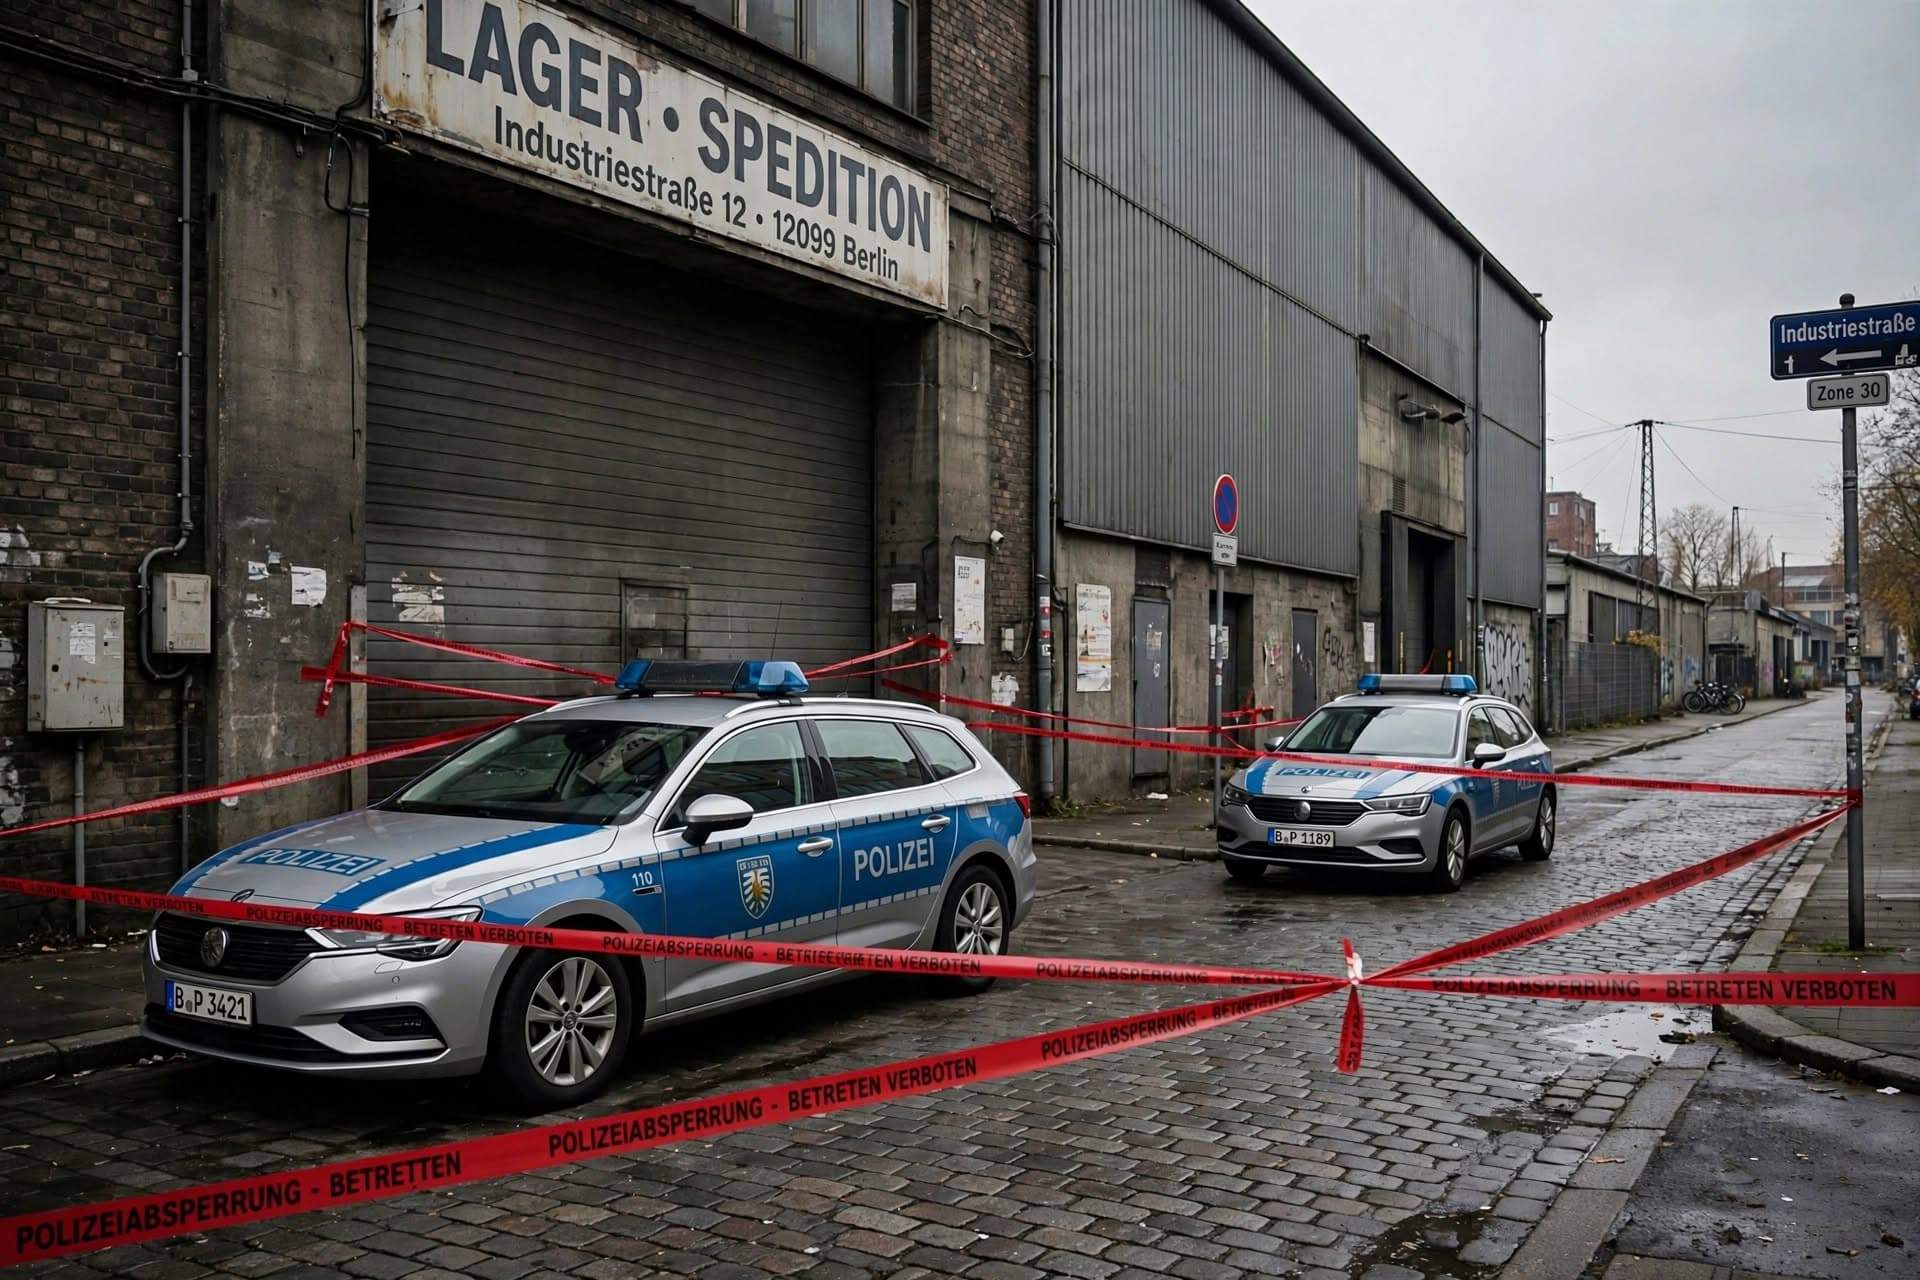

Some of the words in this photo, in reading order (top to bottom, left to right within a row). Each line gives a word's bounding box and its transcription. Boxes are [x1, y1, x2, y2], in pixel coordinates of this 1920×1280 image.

[426, 0, 643, 144] LAGER
[697, 97, 932, 253] SPEDITION
[495, 105, 713, 217] Industriestraße
[721, 192, 747, 229] 12
[772, 210, 836, 259] 12099
[843, 241, 899, 281] Berlin
[1781, 312, 1916, 343] Industriestraße
[1817, 386, 1854, 401] Zone
[1861, 382, 1881, 398] 30
[1280, 767, 1367, 779] POLIZEI
[1275, 830, 1283, 842] B
[1290, 832, 1298, 842] P
[1301, 832, 1331, 845] 1189
[249, 848, 377, 875] POLIZEI
[854, 837, 936, 881] POLIZEI
[632, 870, 653, 886] 110
[246, 907, 384, 933] POLIZEIABSPERRUNG
[403, 922, 475, 939] BETRETEN
[478, 928, 554, 945] VERBOTEN
[603, 935, 755, 961] POLIZEIABSPERRUNG
[900, 955, 982, 975] VERBOTEN
[1036, 962, 1208, 984] POLIZEIABSPERRUNG
[175, 986, 184, 1009] B
[194, 990, 204, 1013] P
[207, 992, 247, 1022] 3421
[1433, 978, 1640, 998] POLIZEIABSPERRUNG
[1666, 980, 1774, 1000] BETRETEN
[1779, 979, 1897, 1001] VERBOTEN
[1041, 1009, 1197, 1061] POLIZEIABSPERRUNG
[548, 1097, 764, 1158] POLIZEIABSPERRUNG
[788, 1081, 882, 1113] BETRETEN
[885, 1056, 978, 1092] VERBOTEN
[16, 1180, 302, 1255] POLIZEIABSPERRUNG
[330, 1151, 463, 1198] BETRETTEN
